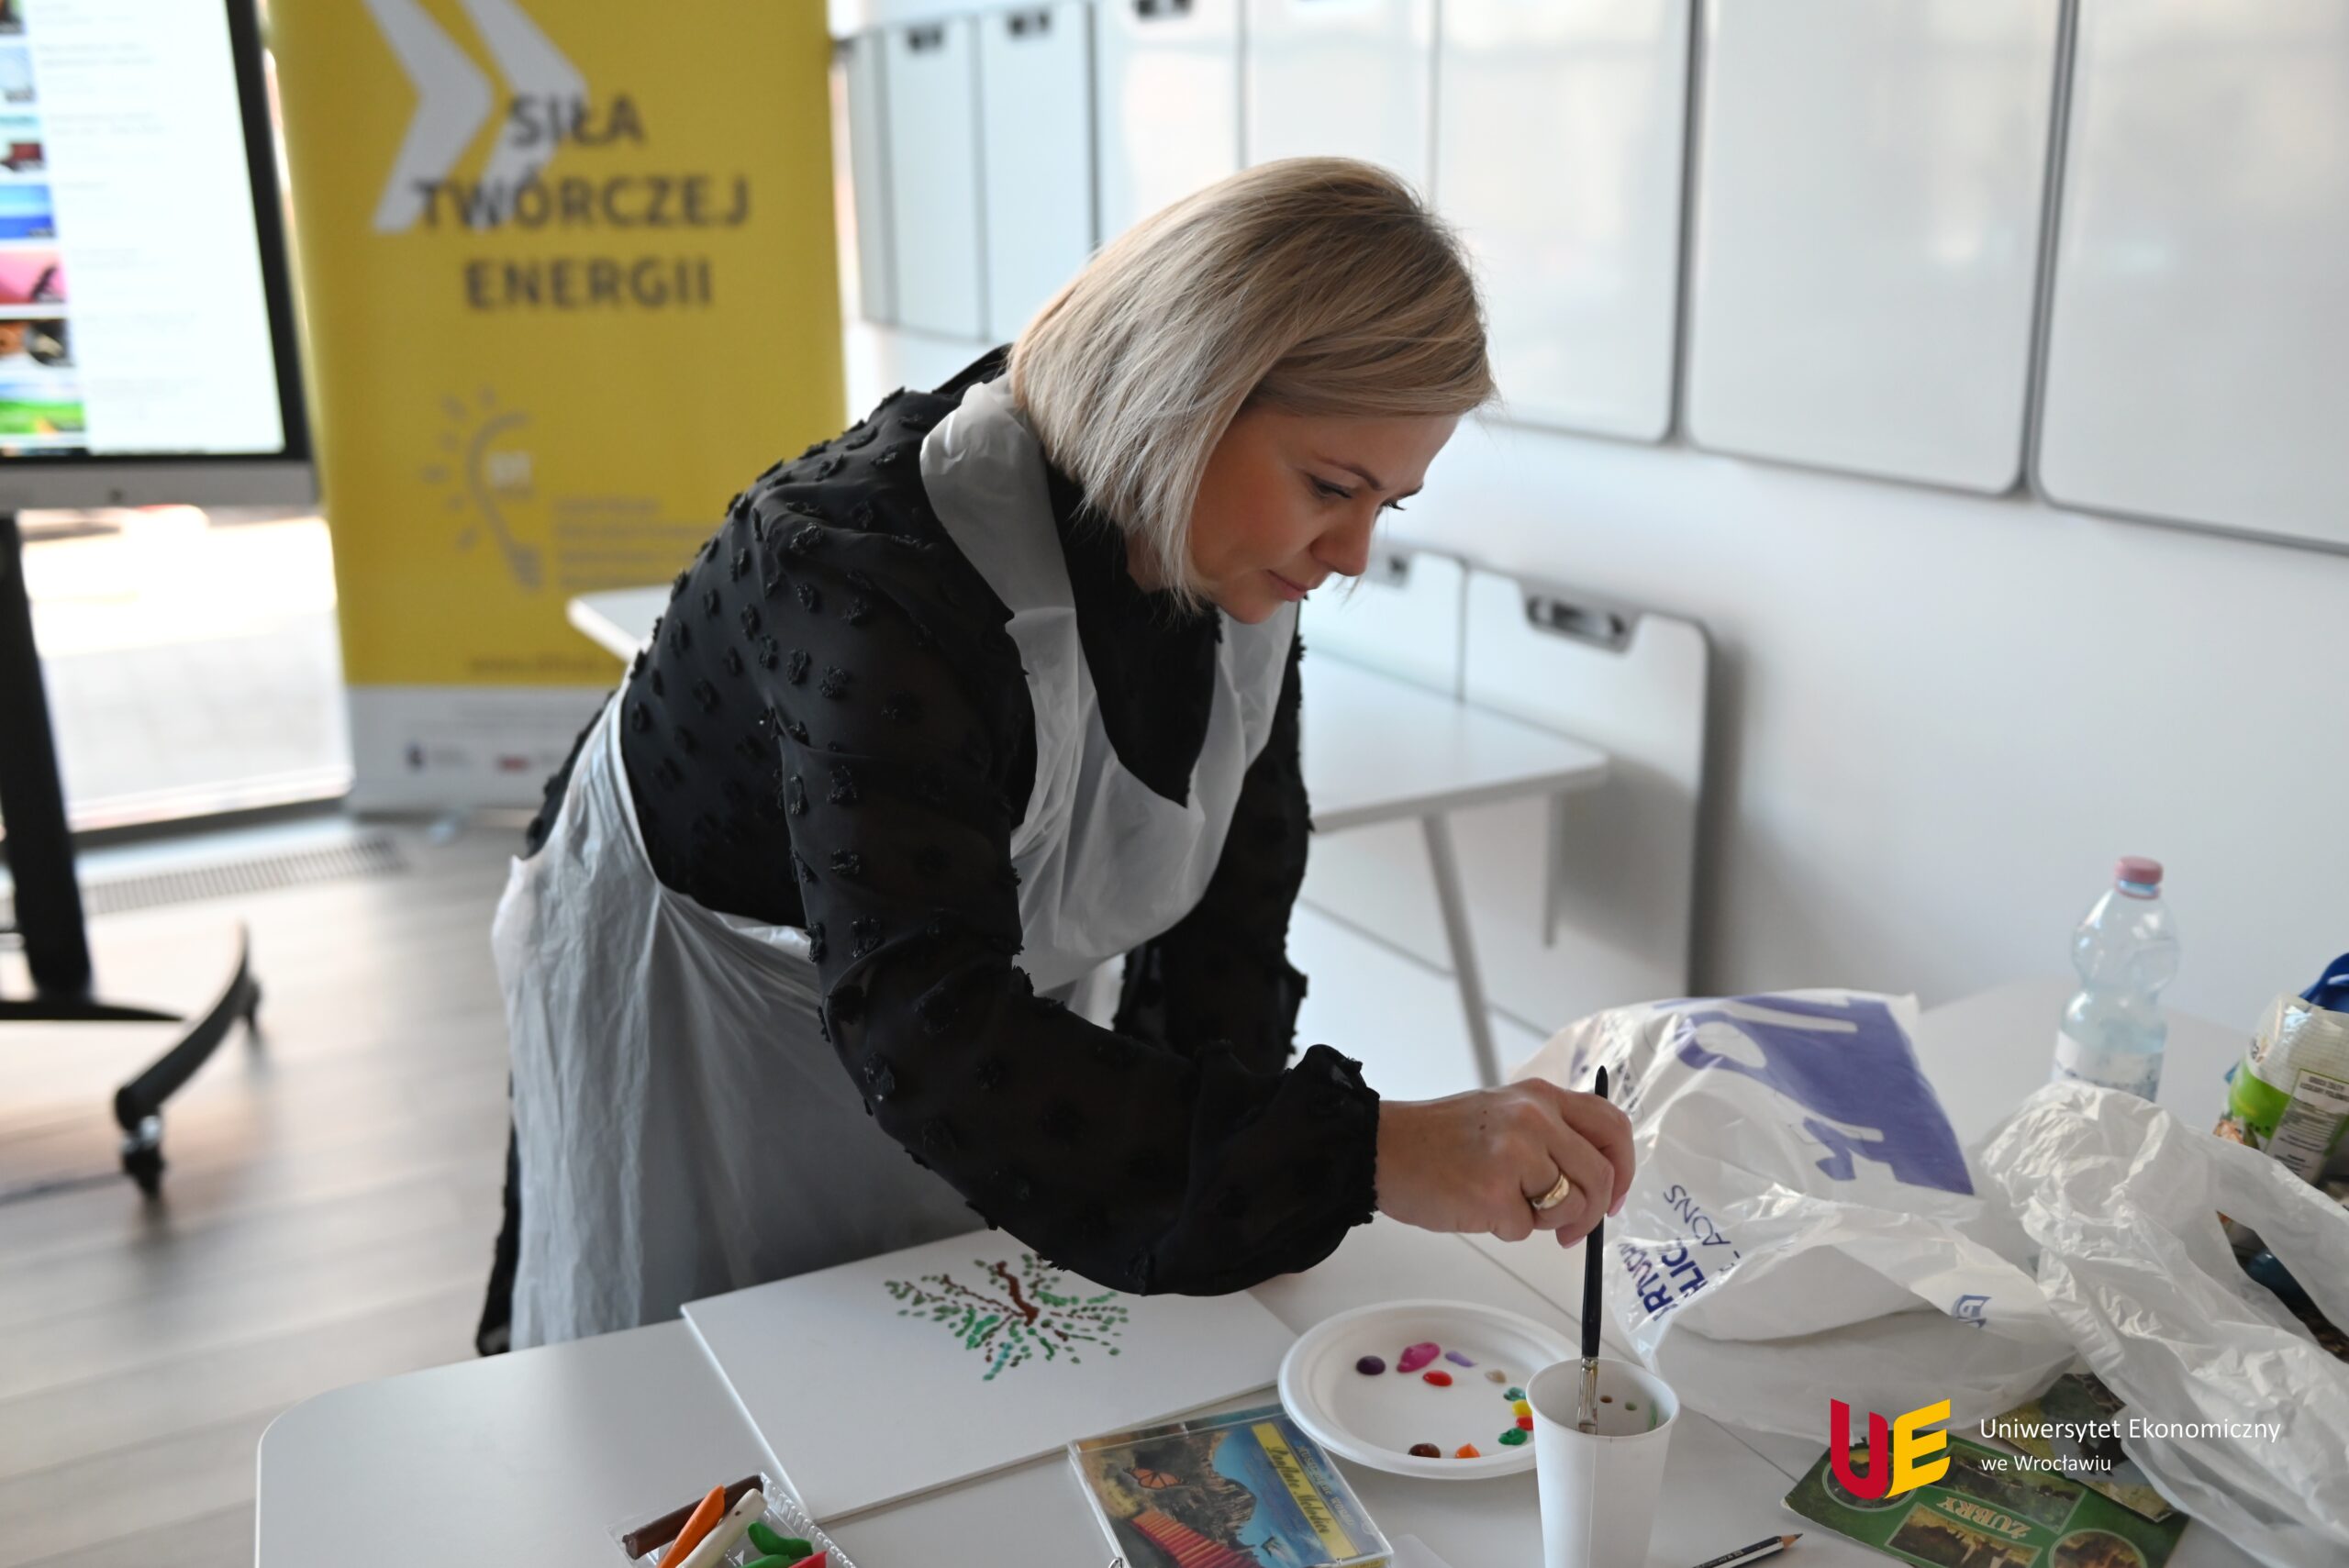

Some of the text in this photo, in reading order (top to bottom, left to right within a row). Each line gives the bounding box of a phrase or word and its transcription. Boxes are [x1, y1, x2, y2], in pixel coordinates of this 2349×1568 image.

[510, 93, 647, 146] SIŁA
[413, 163, 750, 229] TWÓRCZEJ
[464, 256, 713, 311] ENERGII
[1936, 1496, 2032, 1540] ŻUBRY
